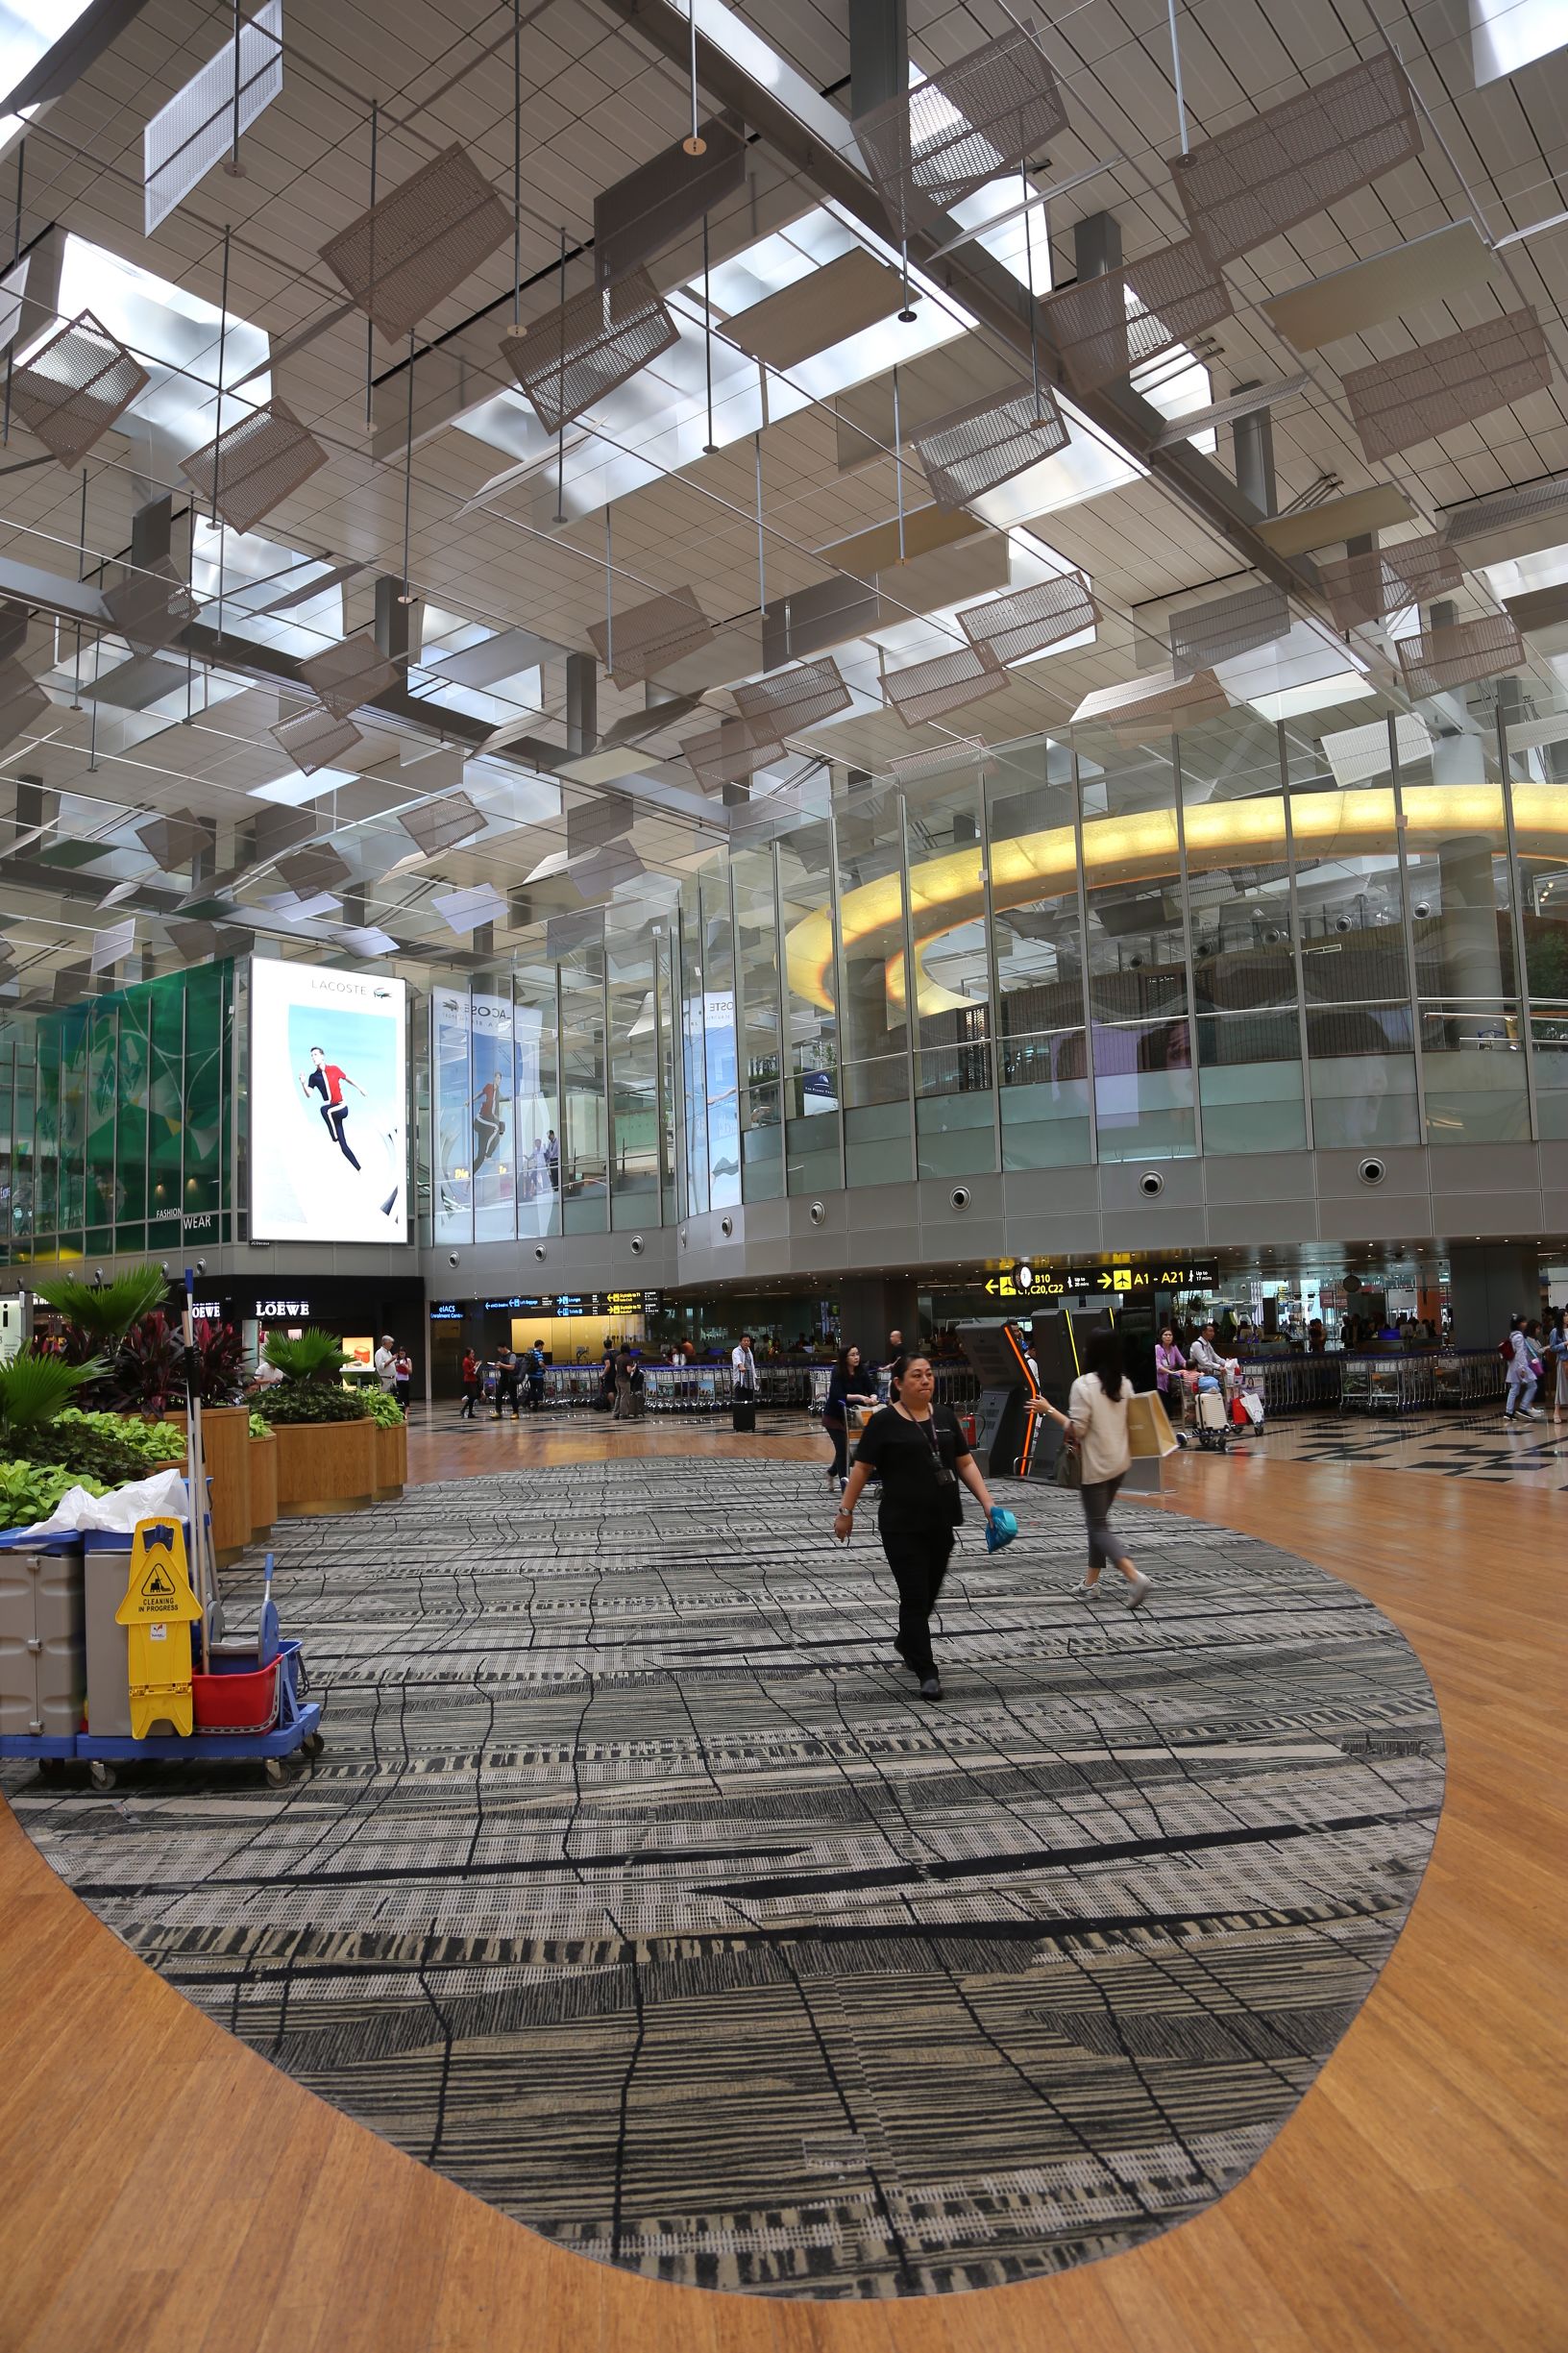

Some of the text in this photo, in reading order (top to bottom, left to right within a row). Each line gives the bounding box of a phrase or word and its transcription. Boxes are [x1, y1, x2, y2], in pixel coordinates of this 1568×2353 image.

[312, 979, 366, 995] LACOSTE
[156, 1208, 182, 1219] FASHION
[183, 1215, 211, 1230] WEAR
[1134, 1273, 1149, 1285] A1
[1161, 1271, 1183, 1284] A21
[192, 1306, 220, 1318] OEWE
[256, 1304, 310, 1317] LOEWE
